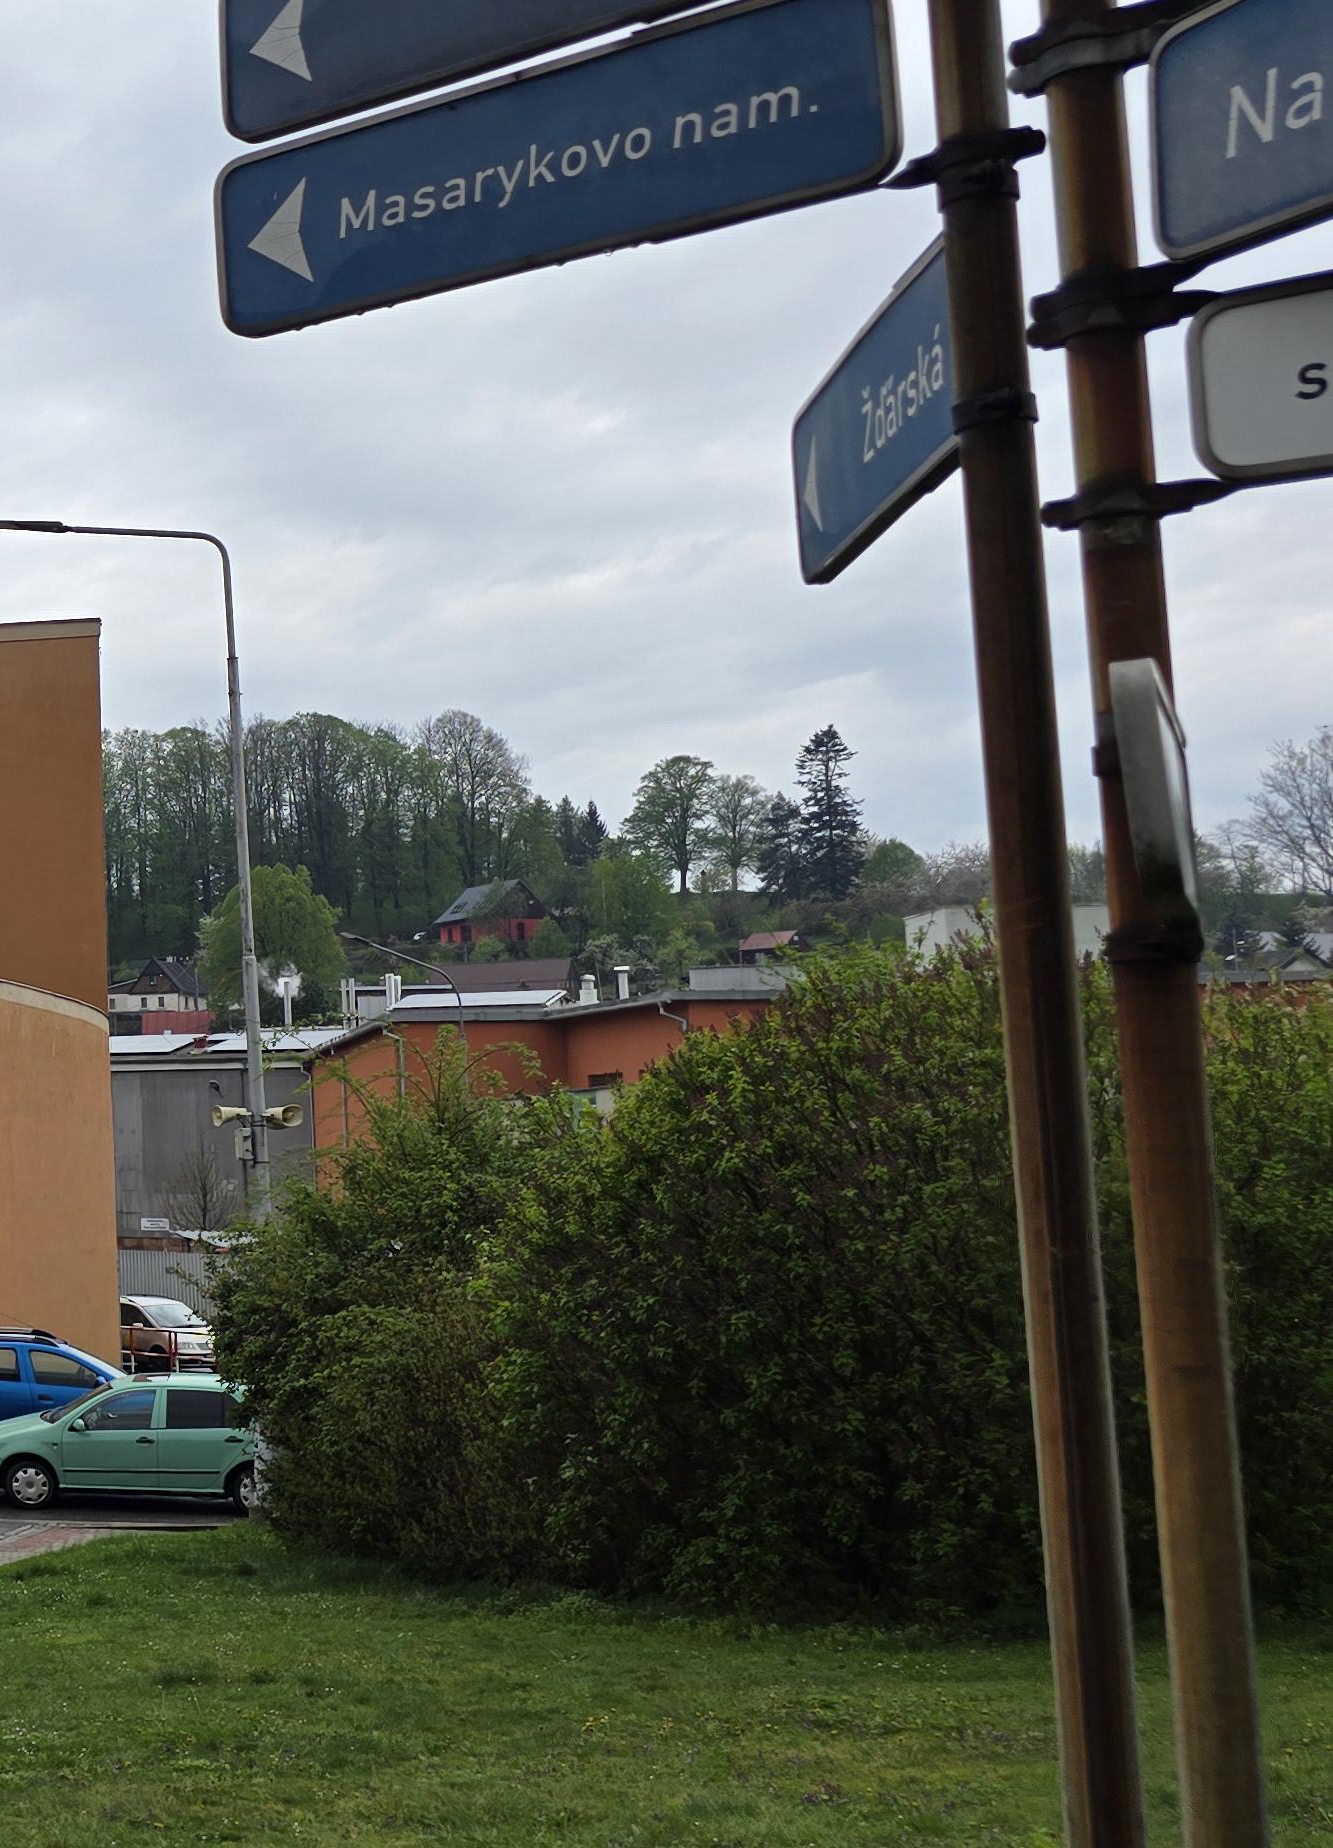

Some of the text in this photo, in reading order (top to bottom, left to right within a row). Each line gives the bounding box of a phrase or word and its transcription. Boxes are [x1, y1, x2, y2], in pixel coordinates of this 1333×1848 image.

[339, 86, 819, 239] Masarykovo nam.
[861, 323, 944, 463] Žďárská
